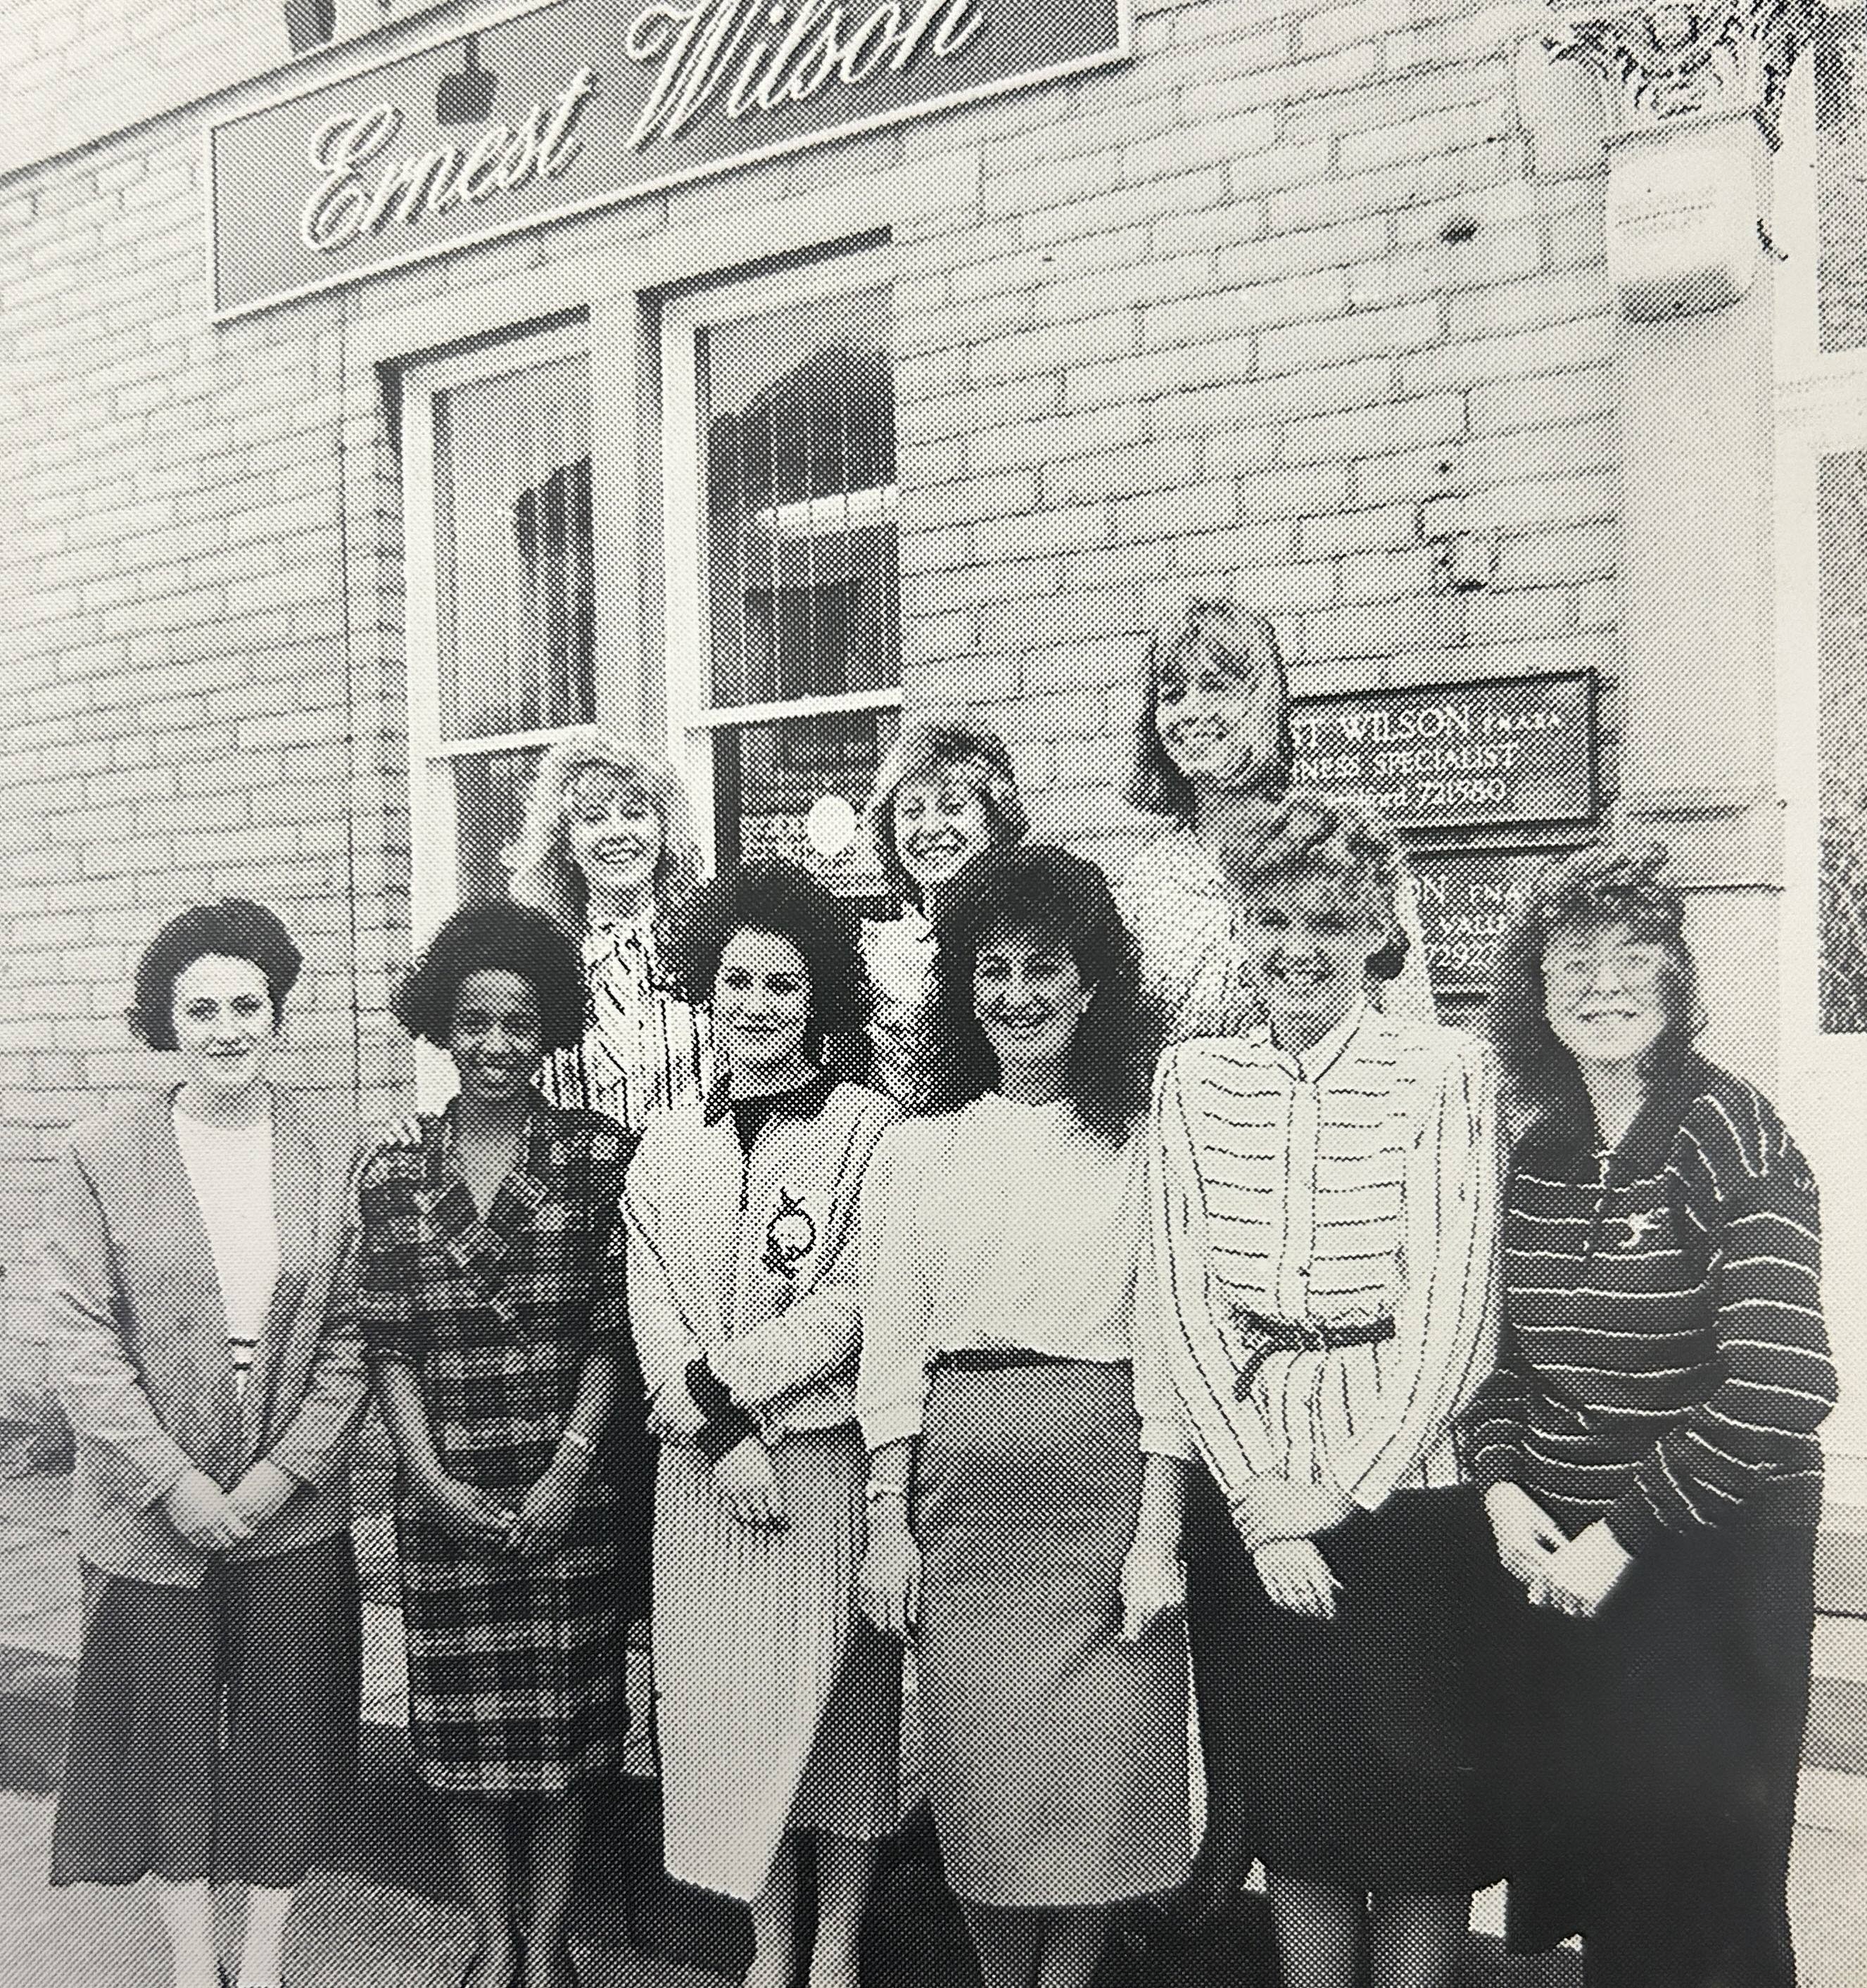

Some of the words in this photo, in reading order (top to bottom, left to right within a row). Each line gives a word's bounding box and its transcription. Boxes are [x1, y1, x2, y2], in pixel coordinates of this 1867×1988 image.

[304, 65, 595, 251] Ernest
[627, 0, 983, 148] Wilson
[1338, 704, 1469, 742] WILSON
[1373, 742, 1519, 775] SPECIALIST
